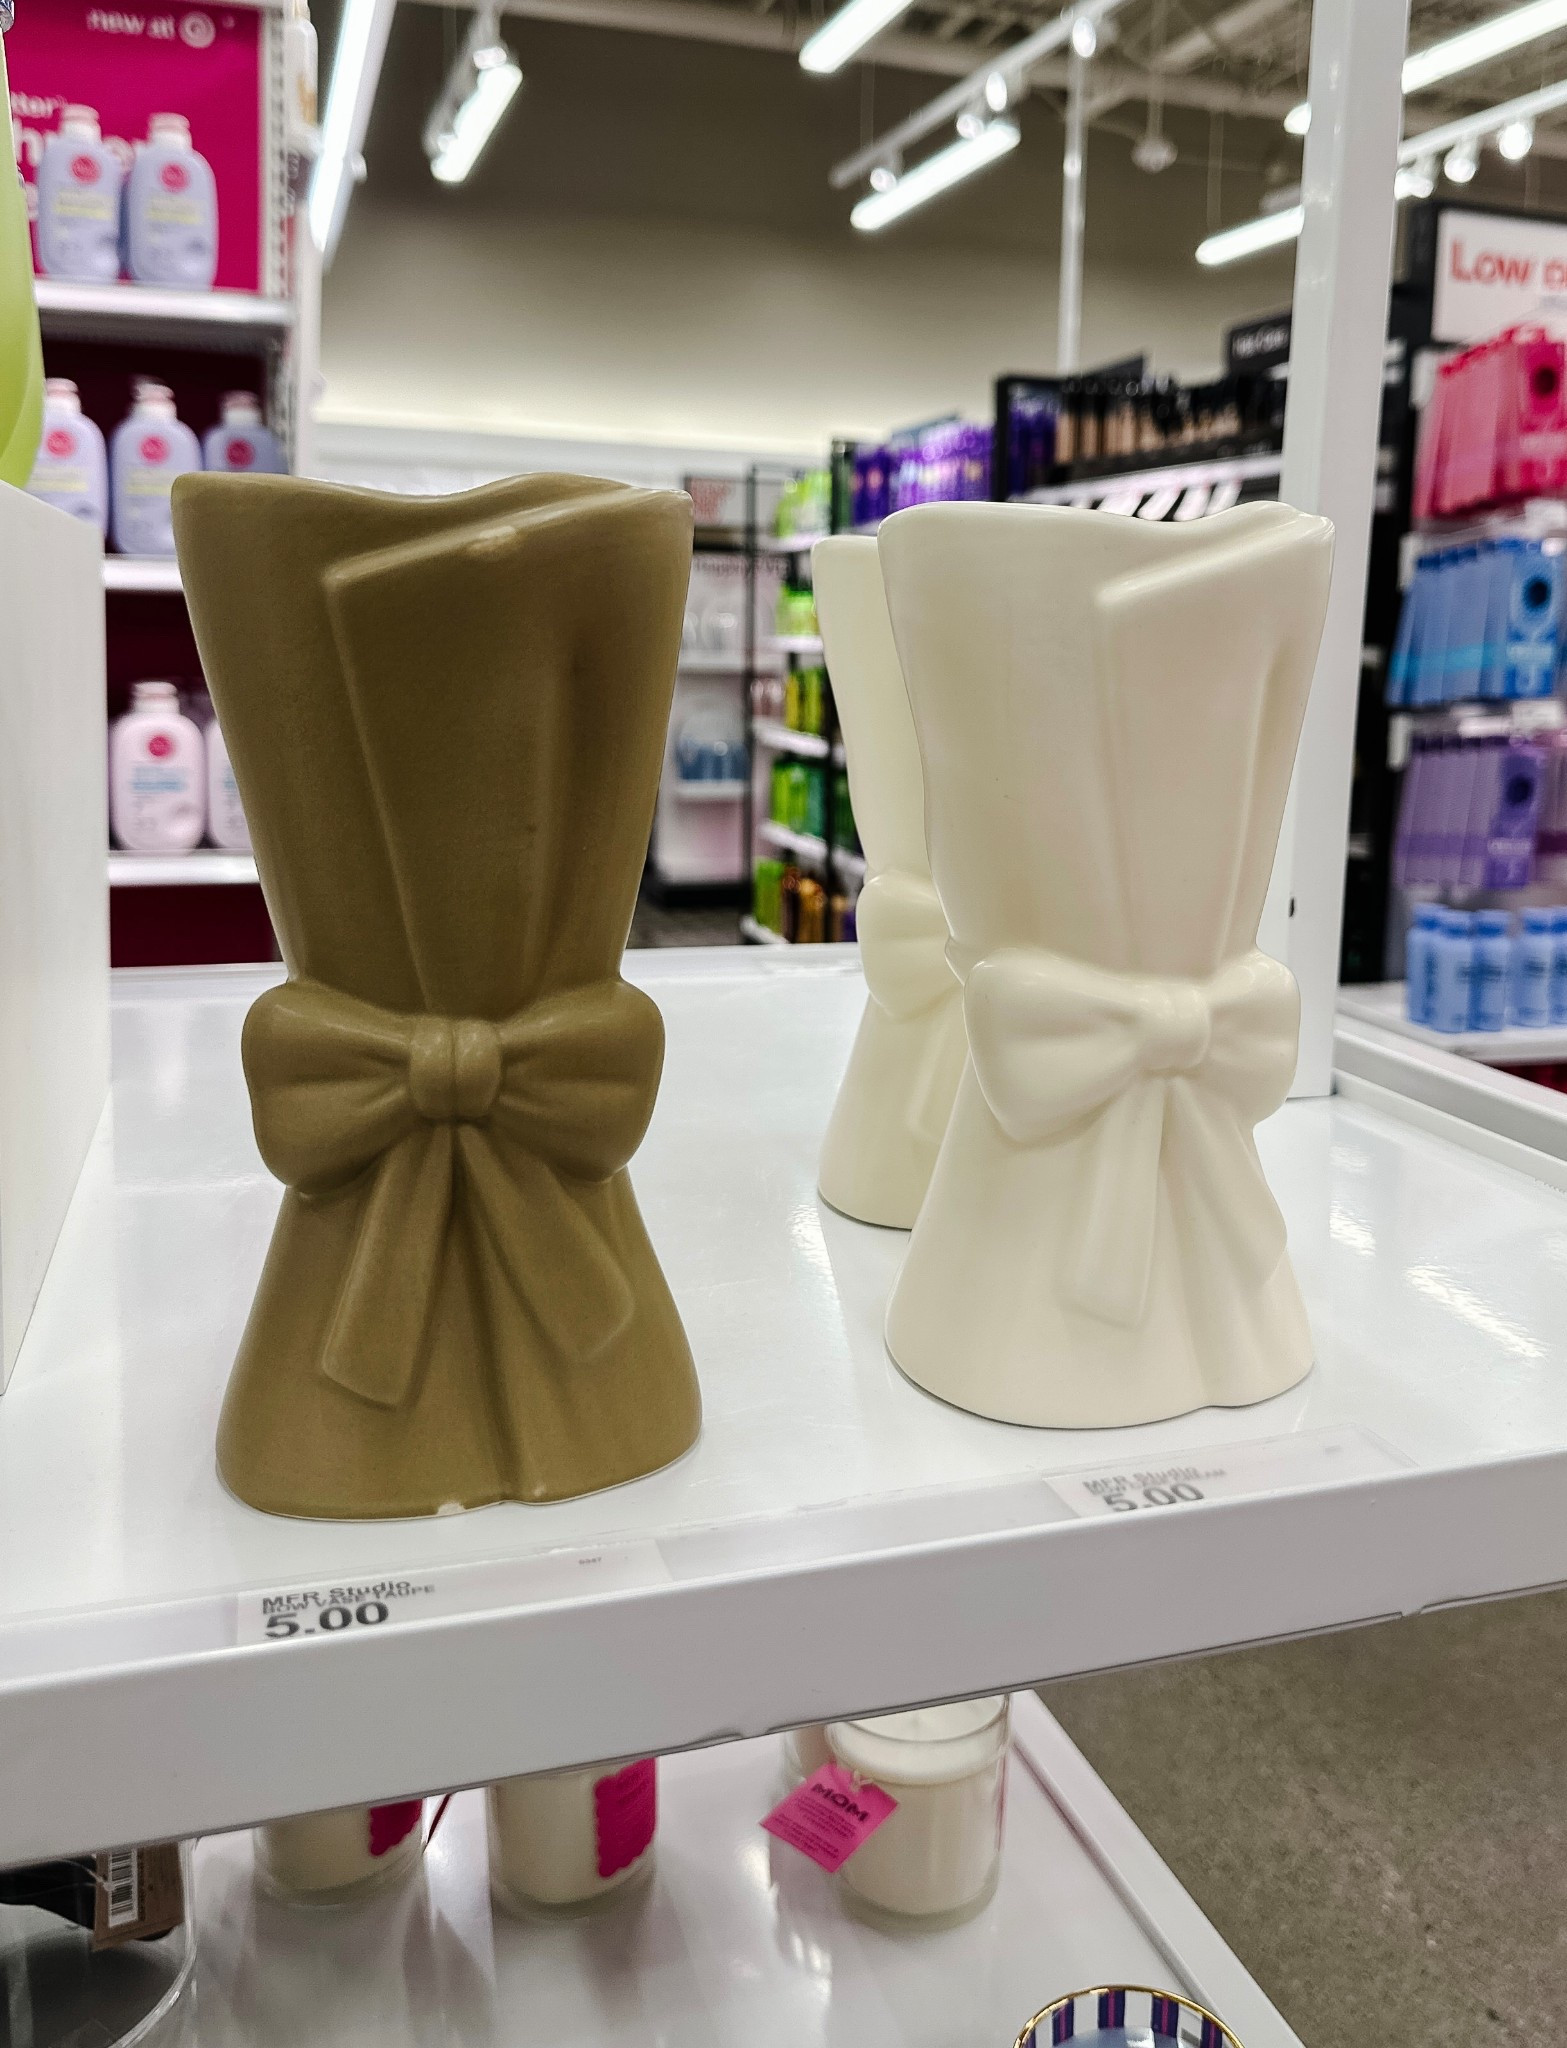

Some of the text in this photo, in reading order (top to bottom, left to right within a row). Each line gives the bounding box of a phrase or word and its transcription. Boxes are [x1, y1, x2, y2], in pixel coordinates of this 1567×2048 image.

[87, 8, 145, 35] new
[1103, 1483, 1204, 1512] 5.00
[329, 1580, 411, 1597] Studio
[265, 1601, 389, 1638] 5.00
[811, 1783, 869, 1822] MOM
